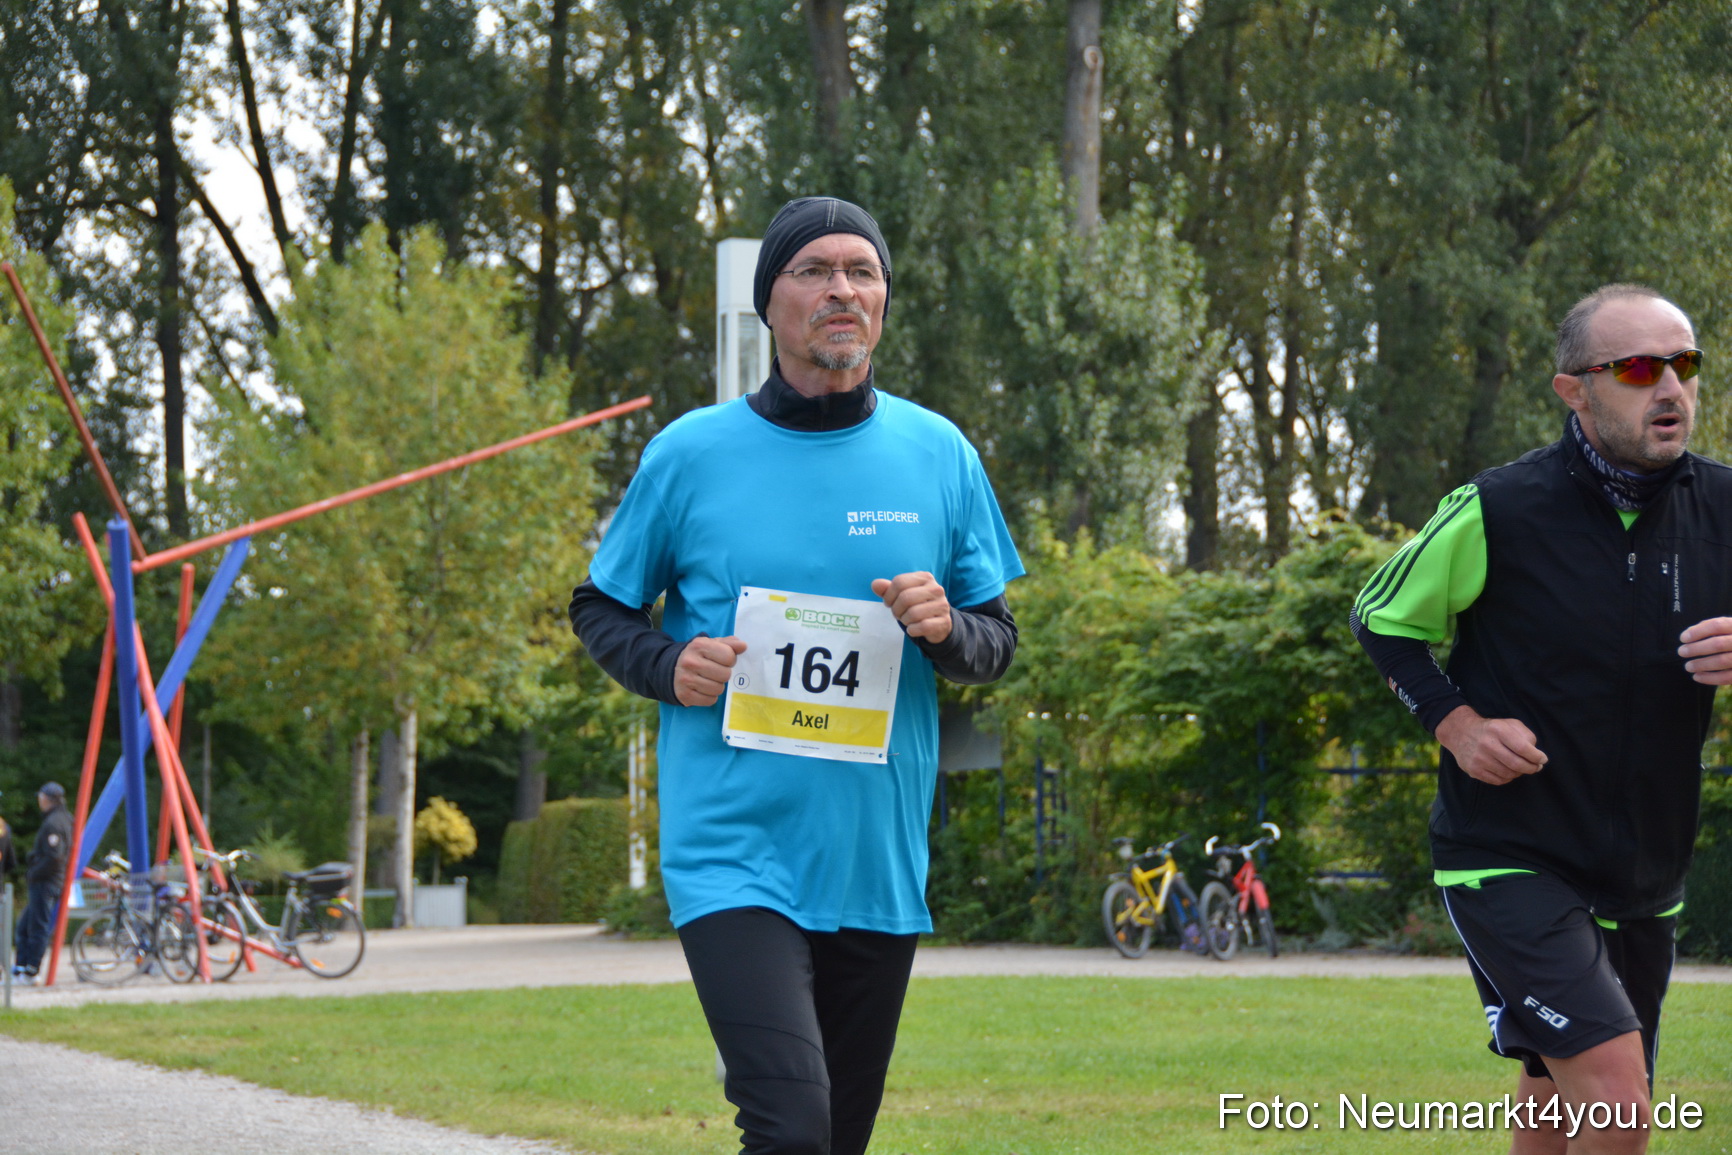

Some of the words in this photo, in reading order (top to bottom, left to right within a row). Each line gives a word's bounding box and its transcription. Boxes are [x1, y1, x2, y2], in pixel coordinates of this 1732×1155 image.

[859, 511, 920, 523] PFLEIDERER
[848, 525, 877, 536] Axel
[802, 609, 860, 629] BOCK
[775, 642, 860, 697] 164
[738, 676, 745, 686] D
[791, 709, 829, 730] Axel
